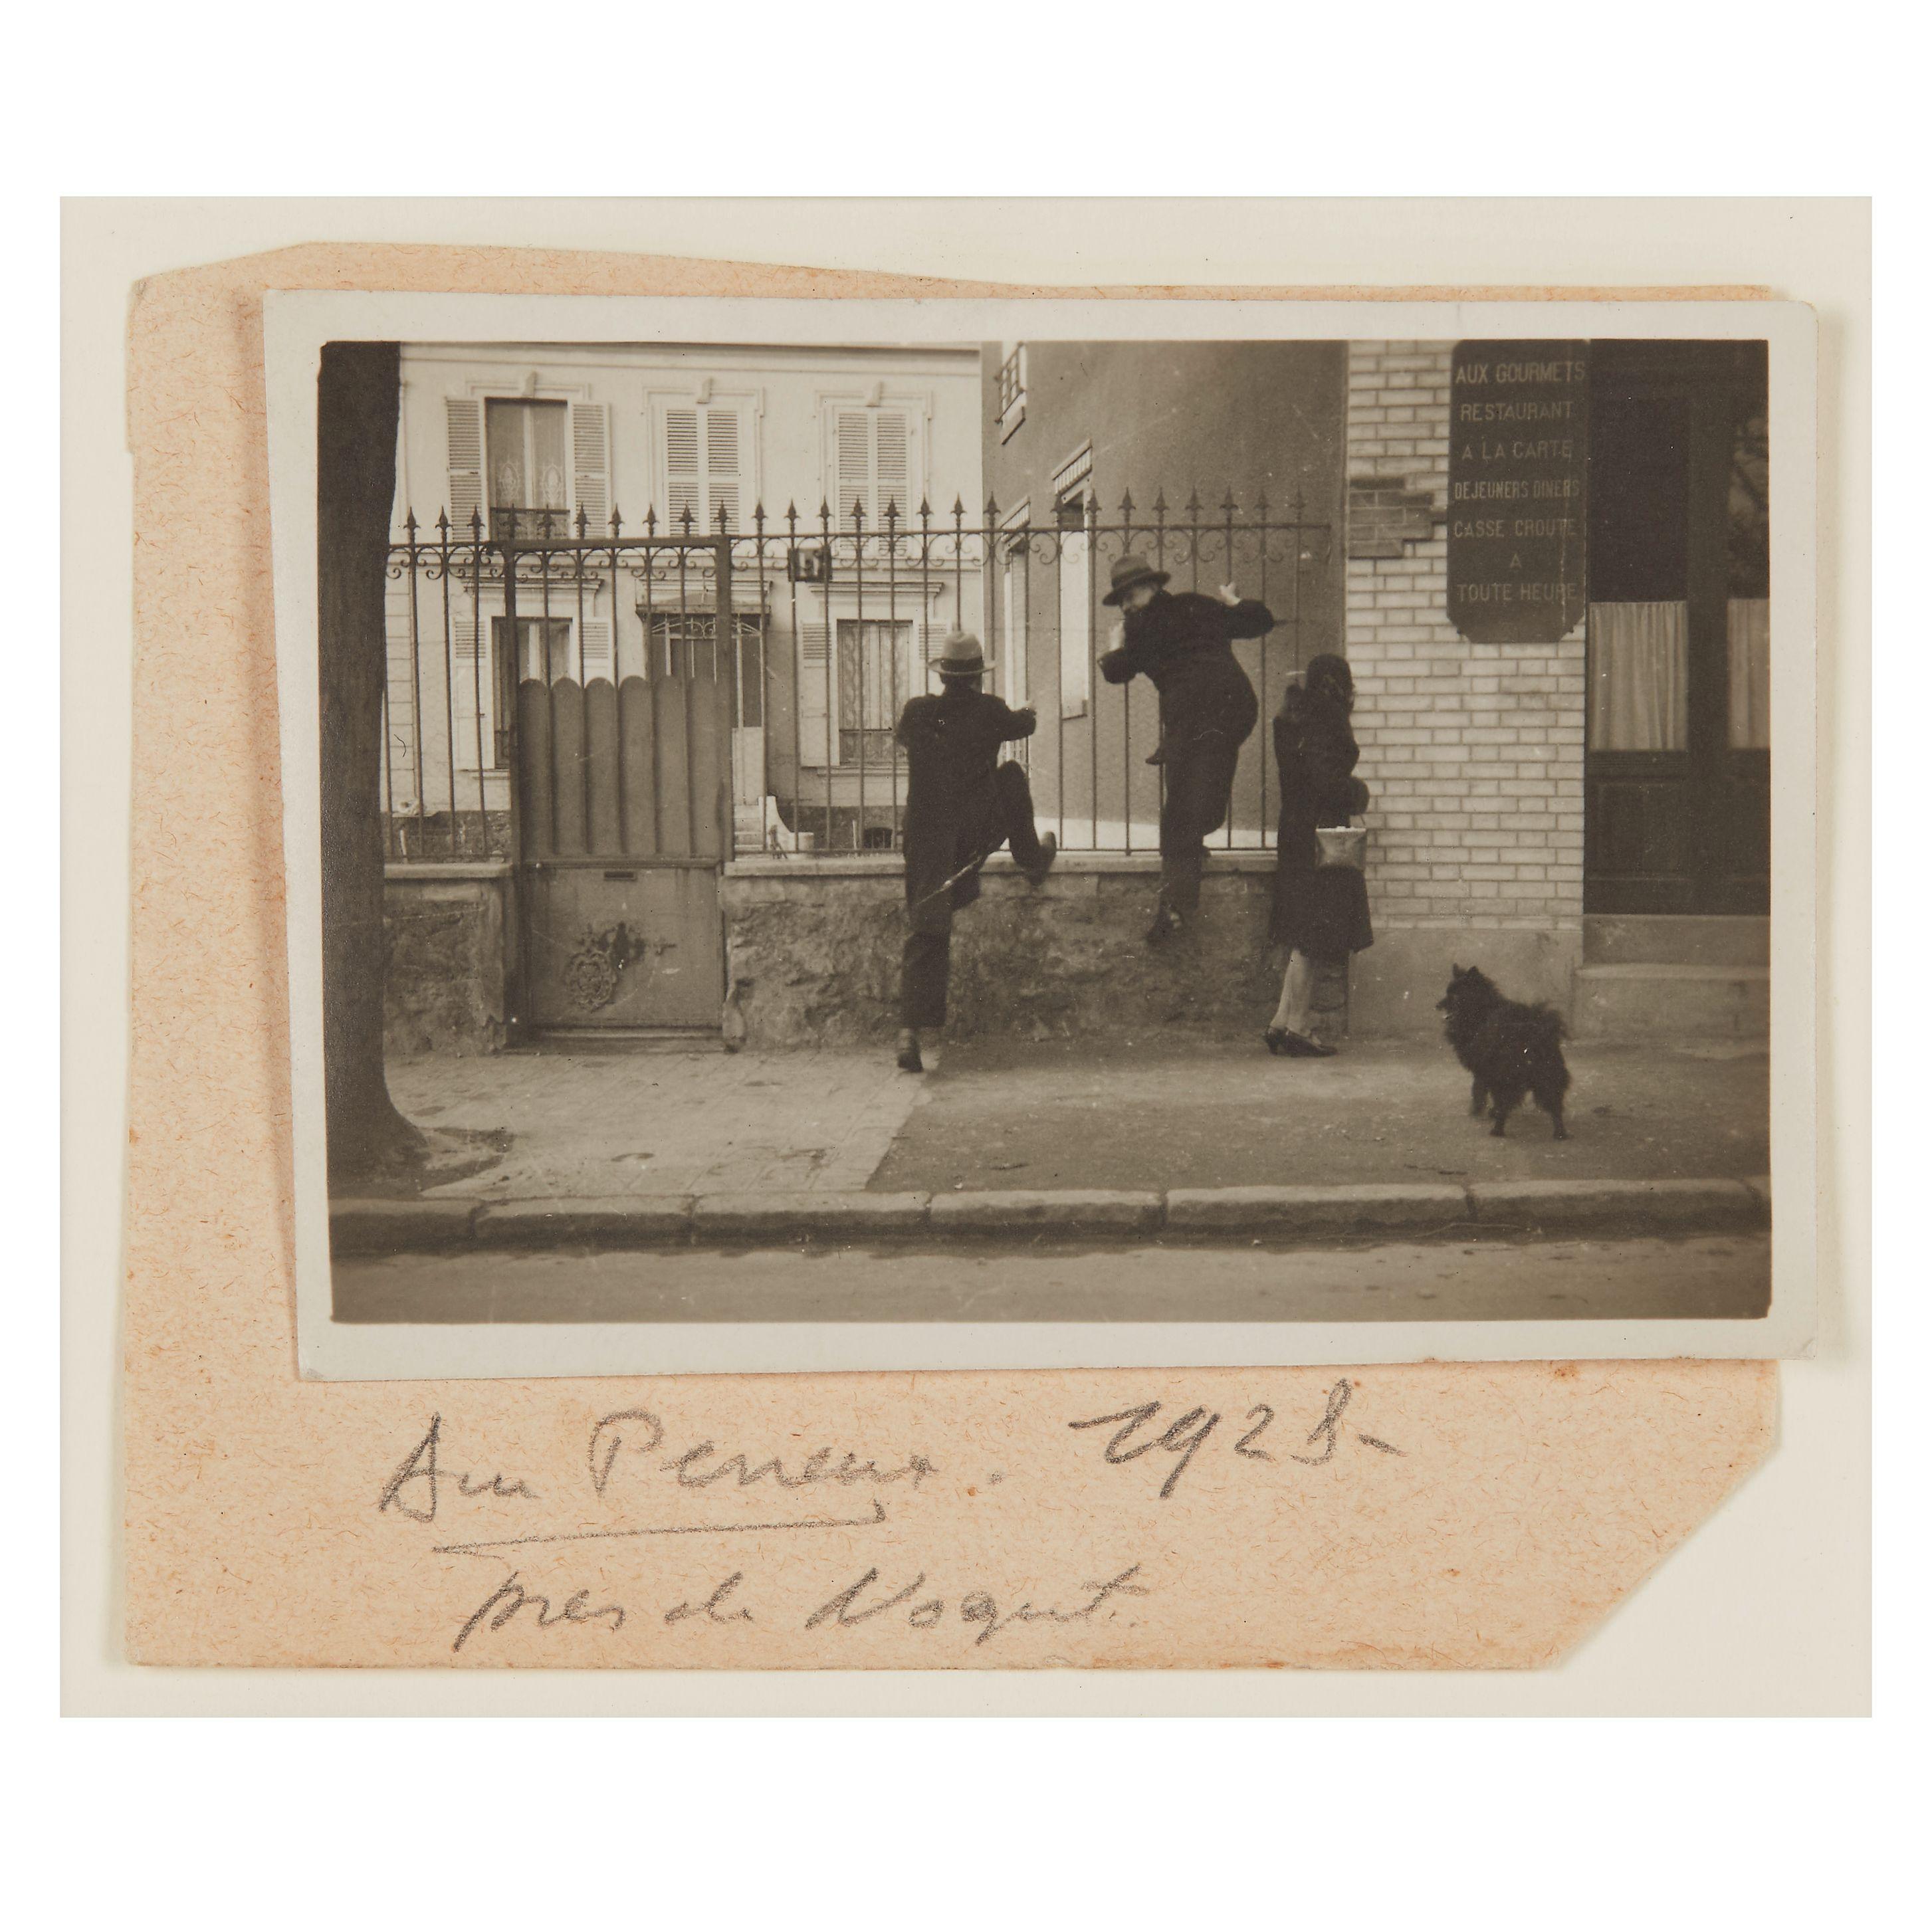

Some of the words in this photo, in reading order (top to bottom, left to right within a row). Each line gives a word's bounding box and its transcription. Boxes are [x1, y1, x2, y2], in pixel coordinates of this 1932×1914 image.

[1455, 363, 1489, 383] AUX
[1496, 361, 1586, 383] GOURMETS
[1461, 401, 1574, 421] RESTAURANT
[1461, 443, 1473, 460] A
[1481, 441, 1506, 460] LA
[1513, 440, 1573, 459] CARTE
[1454, 480, 1529, 499] DEJEUNERS
[1533, 478, 1580, 498] DINERS
[1453, 520, 1505, 538] CASSE
[1515, 518, 1577, 537] CROUTE
[1509, 553, 1523, 569] A
[1456, 583, 1513, 601] TOUTE
[1521, 582, 1578, 601] HEURE
